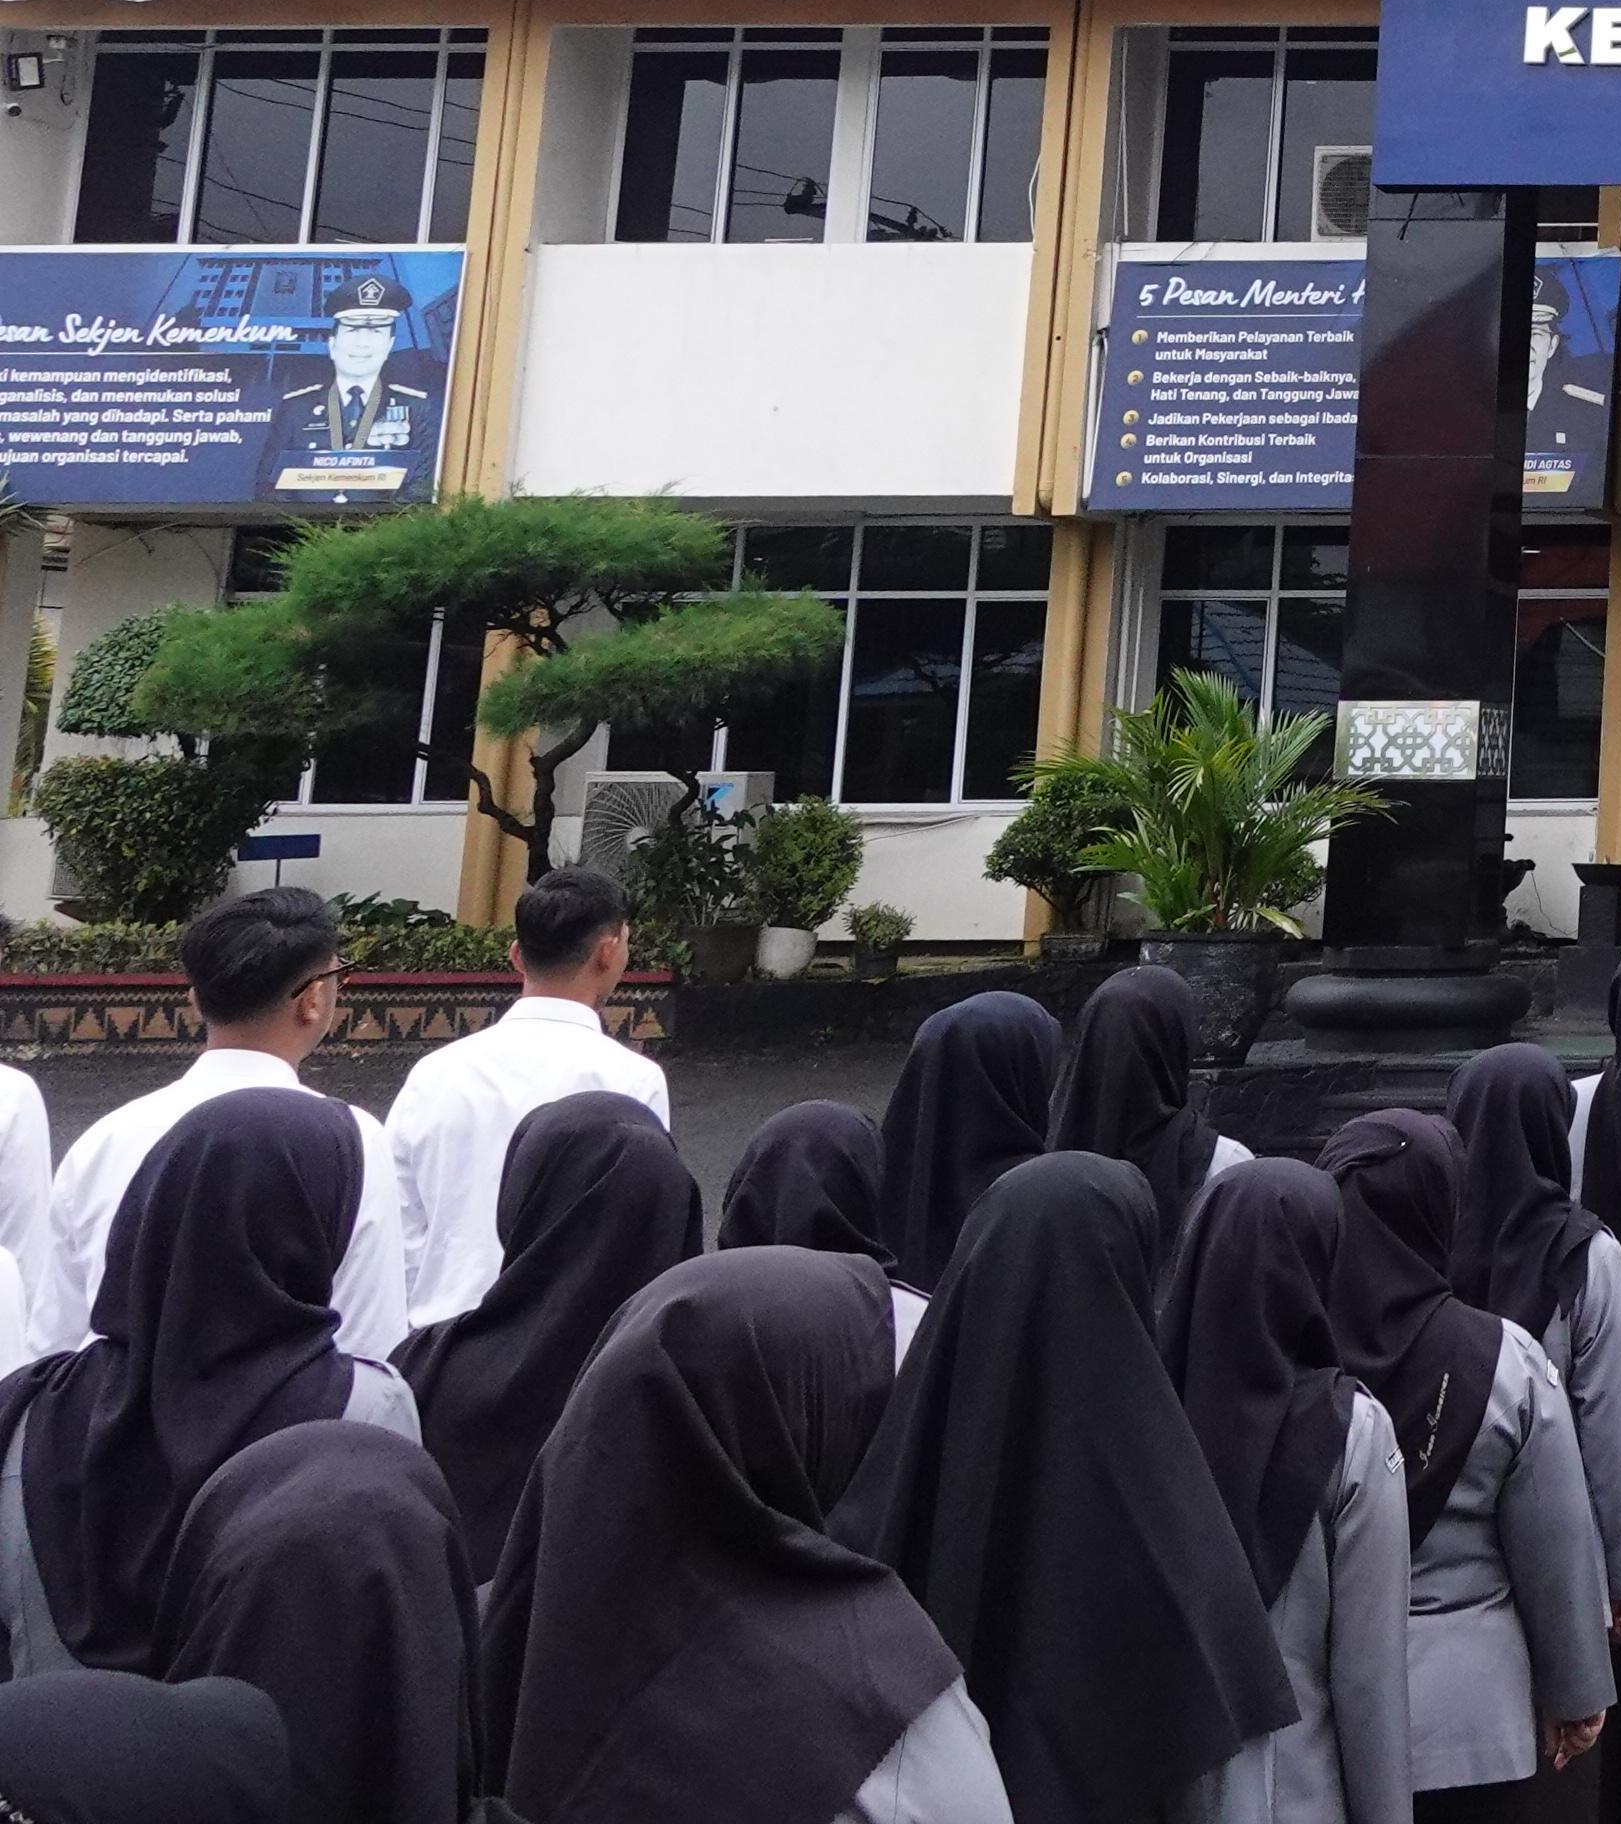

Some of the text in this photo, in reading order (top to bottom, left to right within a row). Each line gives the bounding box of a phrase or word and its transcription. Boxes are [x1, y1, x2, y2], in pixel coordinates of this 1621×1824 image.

[1139, 284, 1160, 306] 5
[1162, 277, 1239, 306] Pesan
[1240, 279, 1346, 308] Menteri
[0, 314, 298, 356] esan Sekjen Kemenkum
[1157, 331, 1354, 345] Memberikan Pelayanan Terbaik
[1155, 348, 1268, 362] untuk Masyarakat
[11, 369, 100, 384] kemampuan
[103, 368, 232, 385] mengidentifikasi,
[1152, 371, 1356, 385] Bekerja dengan Sebaik-baiknya,
[0, 389, 240, 405] ganalisis, dan menemukan solusi
[1151, 388, 1359, 403] Hati Tenang, dan Tanggung Jawa
[63, 410, 98, 425] yang
[101, 409, 169, 425] dihadapi.
[173, 410, 213, 423] Serta
[216, 409, 272, 425] pahami
[1148, 412, 1358, 427] Jadikan Pekerjaan sebagai Ibada
[9, 431, 87, 445] wewenang
[90, 430, 119, 442] dan
[122, 430, 193, 445] tanggung
[193, 430, 243, 445] jawab,
[1146, 433, 1316, 446] Berikan Kontribusi Terbaik
[0, 449, 189, 465] ujuan organisasi tercapai.
[313, 456, 376, 466] NICO AFINTA
[1144, 451, 1252, 466] untuk Organisasi
[1538, 460, 1572, 469] AGTAS
[1141, 472, 1214, 485] Kolaborasi,
[1217, 472, 1266, 486] Sinergi,
[1269, 472, 1293, 483] dan
